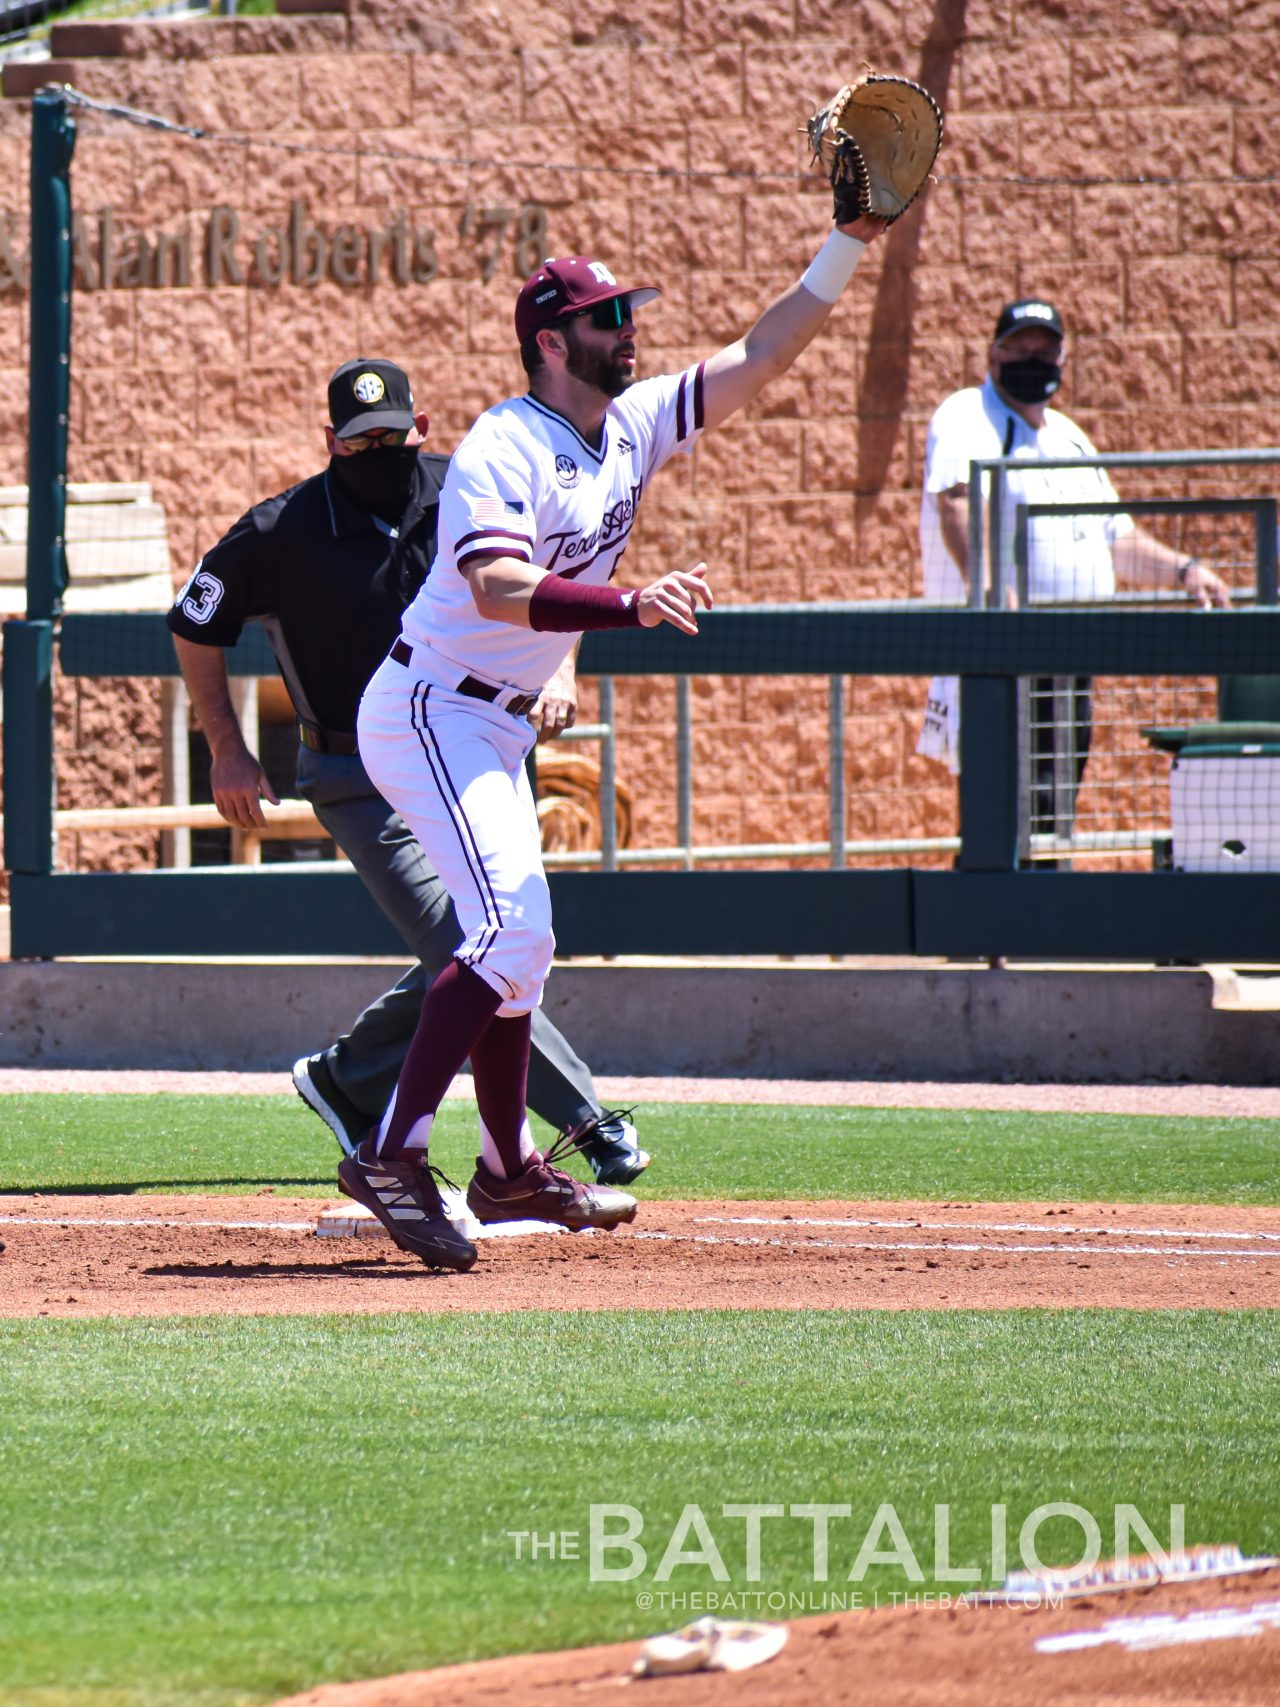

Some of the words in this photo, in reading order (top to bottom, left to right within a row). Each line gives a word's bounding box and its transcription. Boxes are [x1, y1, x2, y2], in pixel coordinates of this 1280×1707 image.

[209, 199, 439, 286] Roberts
[459, 202, 549, 285] '78
[356, 379, 383, 402] SEC
[182, 572, 225, 625] 3
